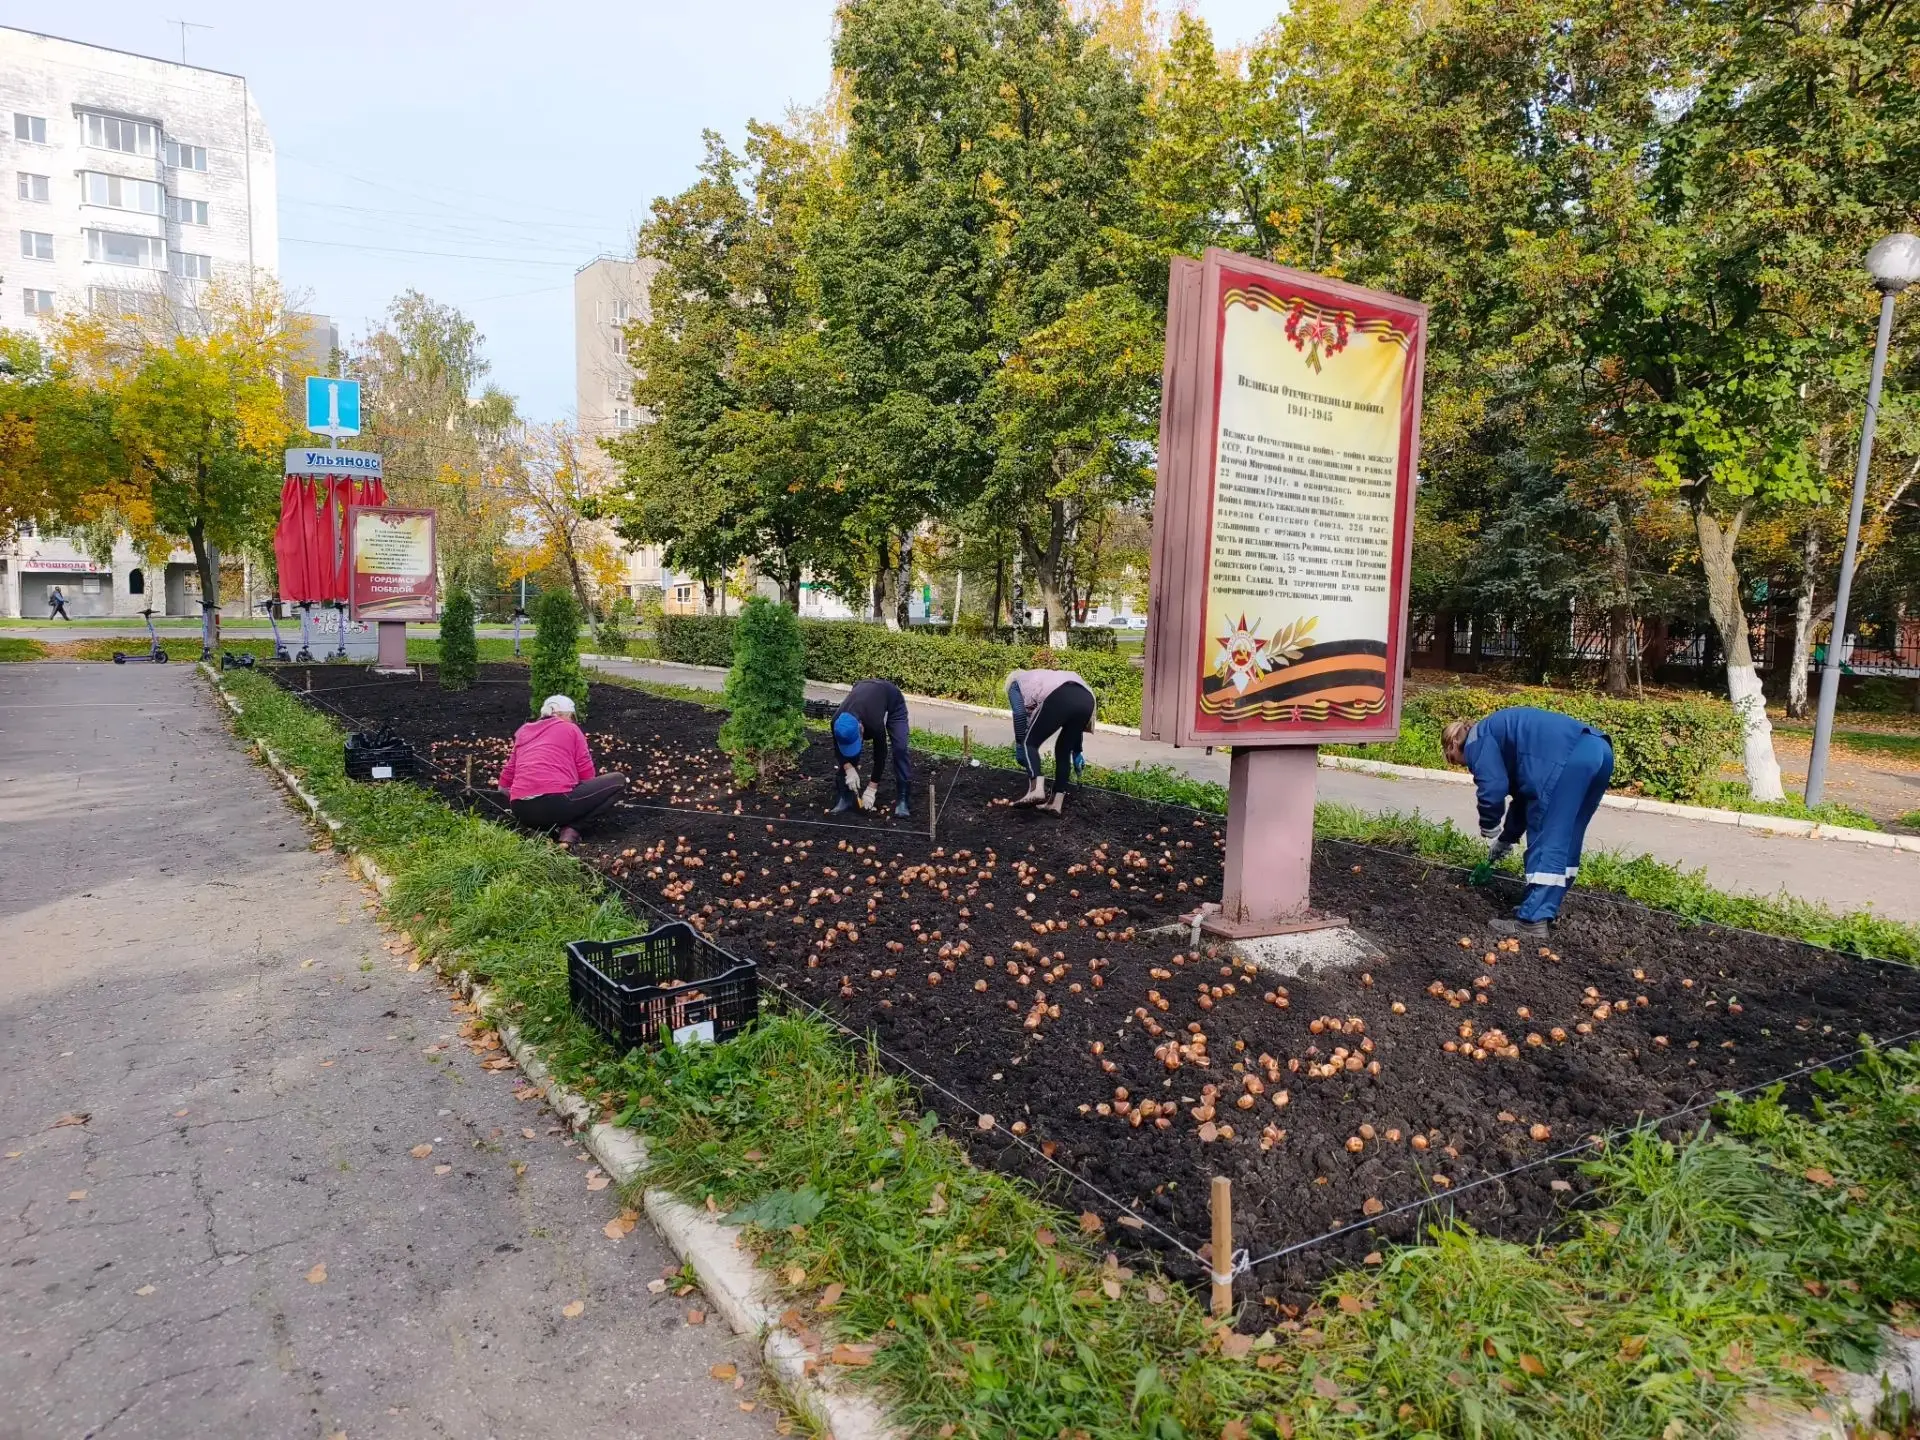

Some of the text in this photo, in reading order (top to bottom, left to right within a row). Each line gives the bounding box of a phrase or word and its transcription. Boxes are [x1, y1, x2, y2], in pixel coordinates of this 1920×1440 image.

[1237, 374, 1385, 415] Великая Отечественная война
[1287, 403, 1333, 422] 1941-1945
[1220, 468, 1230, 476] 22
[1321, 495, 1338, 504] 1945
